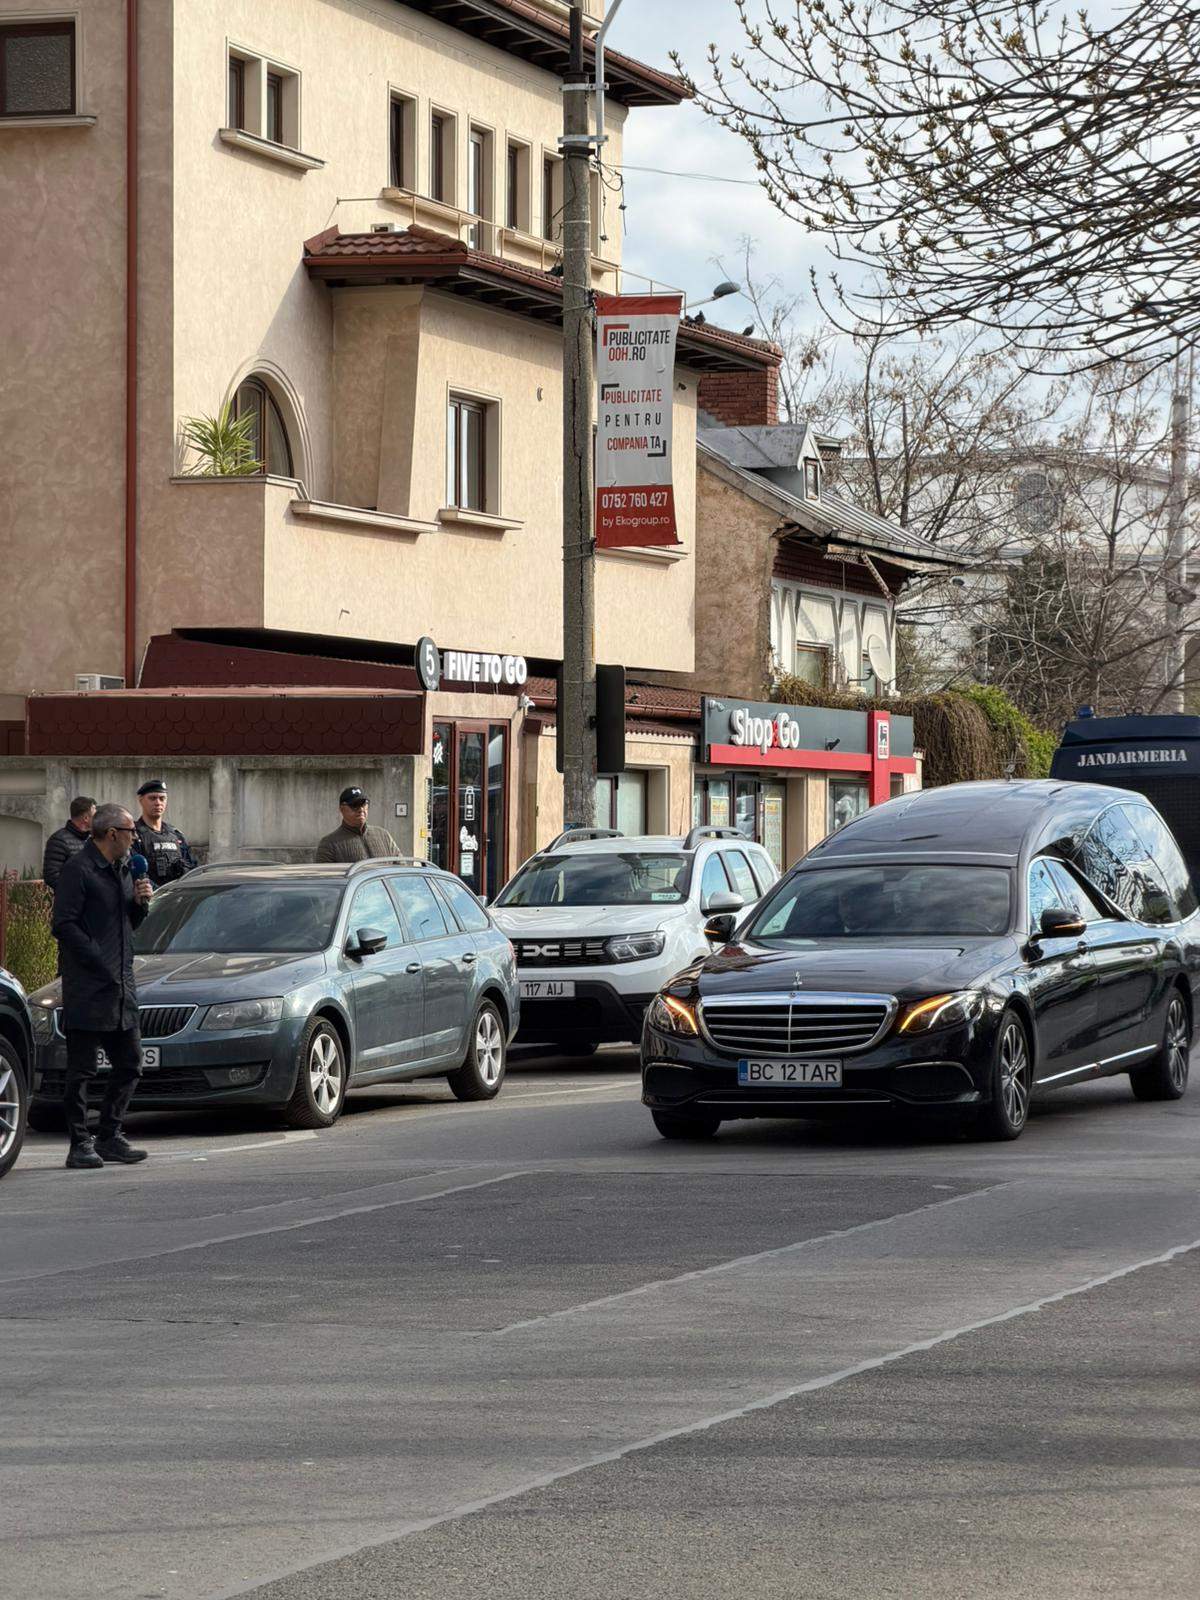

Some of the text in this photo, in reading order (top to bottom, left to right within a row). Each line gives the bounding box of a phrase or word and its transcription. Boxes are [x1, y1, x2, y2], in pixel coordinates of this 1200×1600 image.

[609, 330, 671, 346] PUBLICITATE
[608, 346, 646, 361] OOH.RO
[605, 389, 662, 404] PUBLICITATE
[605, 412, 662, 427] PENTRU
[607, 436, 661, 451] COMPANIA TA
[602, 491, 668, 508] 0752 760 427
[602, 516, 670, 528] by Ekogroup.ro
[426, 644, 435, 676] 5
[445, 651, 527, 685] FIVE TO GO
[1077, 749, 1187, 767] JANDARMERIA
[525, 983, 541, 996] 117
[750, 1063, 774, 1081] BC
